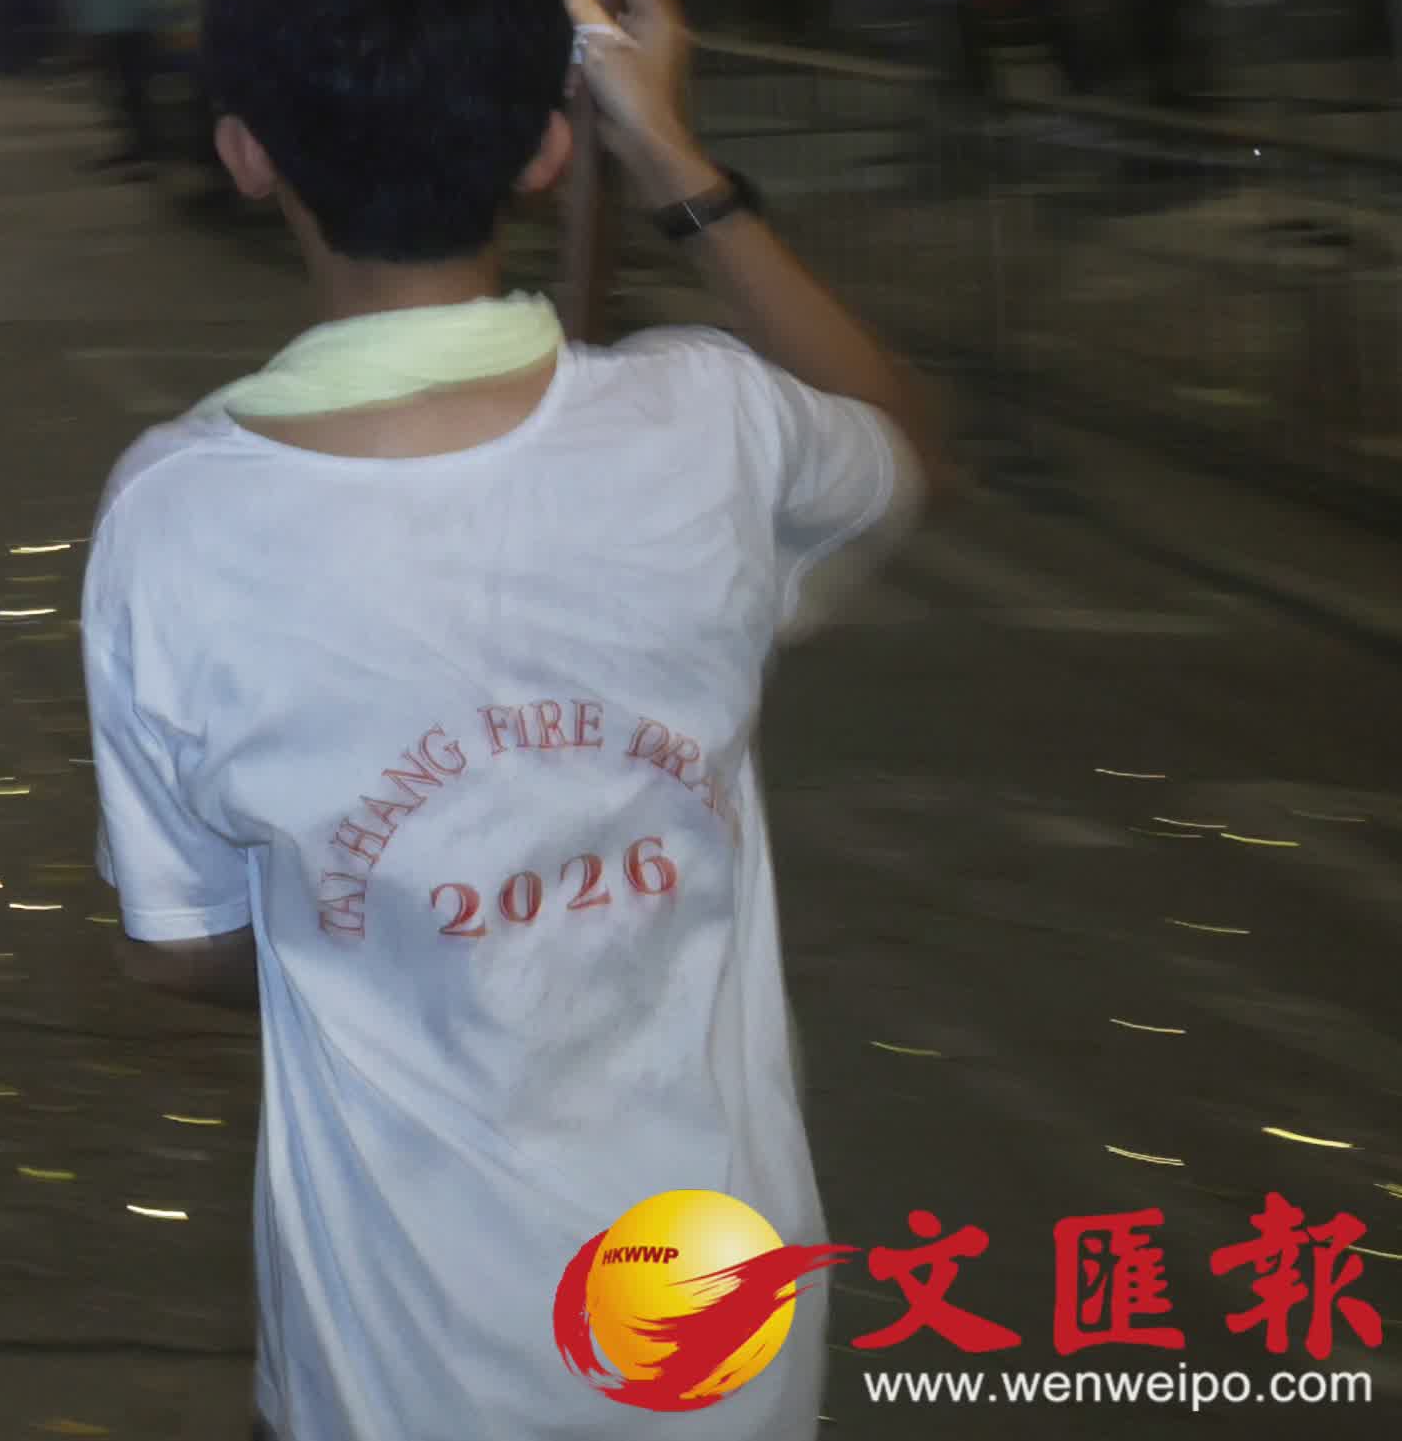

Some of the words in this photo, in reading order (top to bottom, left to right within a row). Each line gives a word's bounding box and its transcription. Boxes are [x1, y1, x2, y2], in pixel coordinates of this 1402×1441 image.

[477, 699, 605, 755] FIRE
[329, 723, 467, 872] HANG
[317, 870, 367, 939] TAI
[430, 836, 678, 938] 2026
